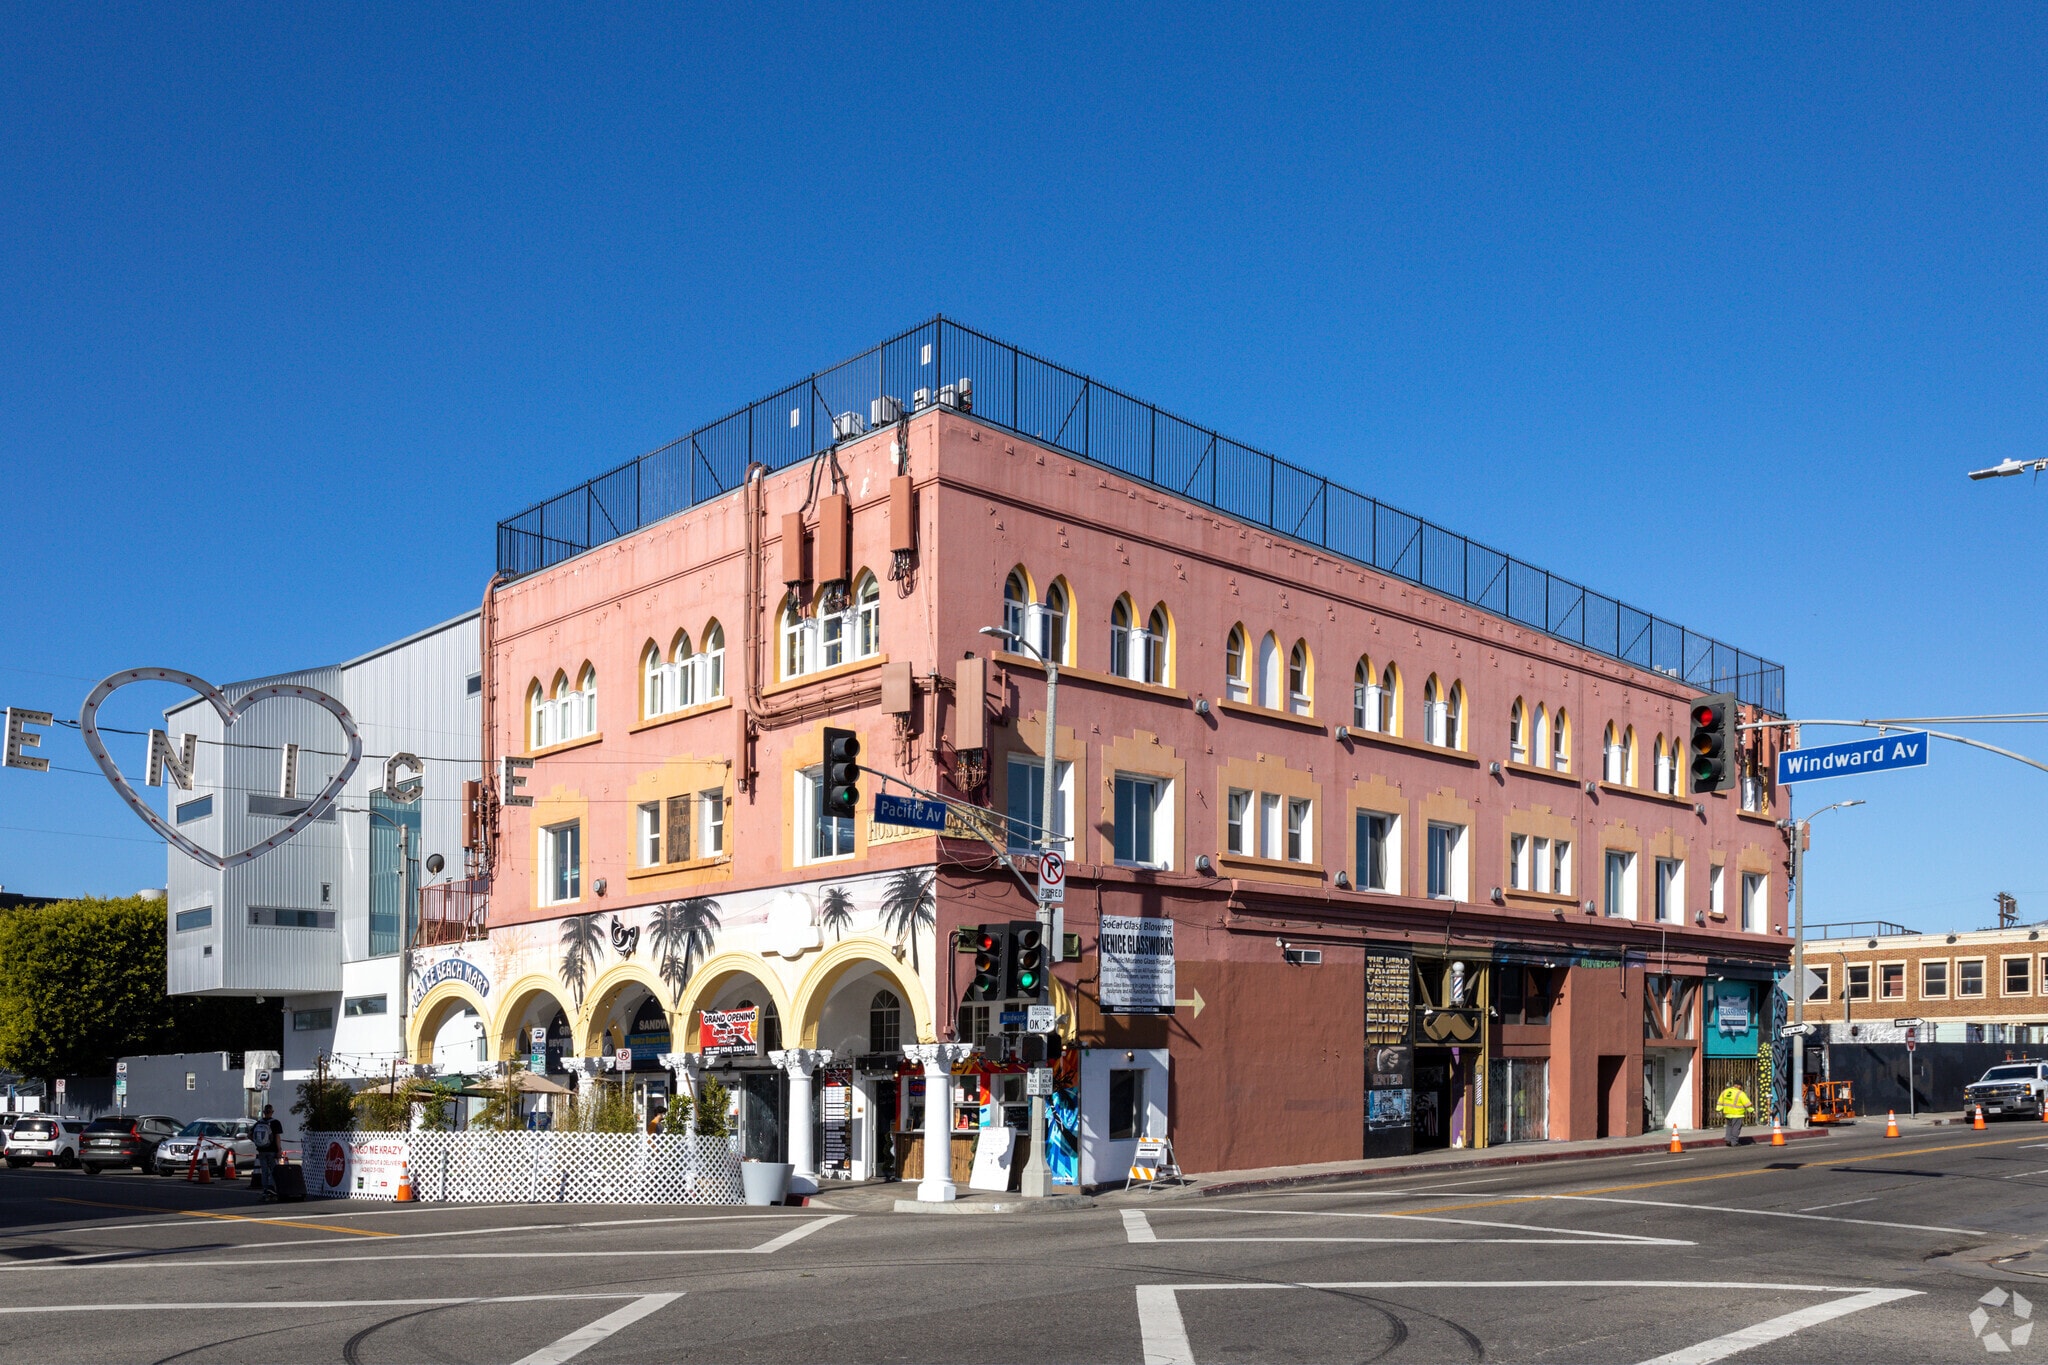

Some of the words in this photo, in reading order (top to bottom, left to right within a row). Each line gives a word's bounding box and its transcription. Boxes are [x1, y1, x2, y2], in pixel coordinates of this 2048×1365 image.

[1787, 745, 1884, 775] Windward
[1891, 742, 1919, 760] Av
[880, 801, 923, 821] Pacific
[926, 807, 942, 822] Av
[1102, 920, 1123, 930] SoCal
[1123, 921, 1142, 931] Glass
[1143, 922, 1172, 935] Blowing
[1101, 933, 1126, 955] VENICE
[1127, 935, 1174, 957] GLASSWORKS
[435, 960, 463, 981] BEACH
[465, 964, 489, 997] MART
[704, 1013, 726, 1024] GRAND
[726, 1011, 756, 1022] OPENING
[1029, 1020, 1040, 1029] OK
[379, 1145, 404, 1155] KRAZY
